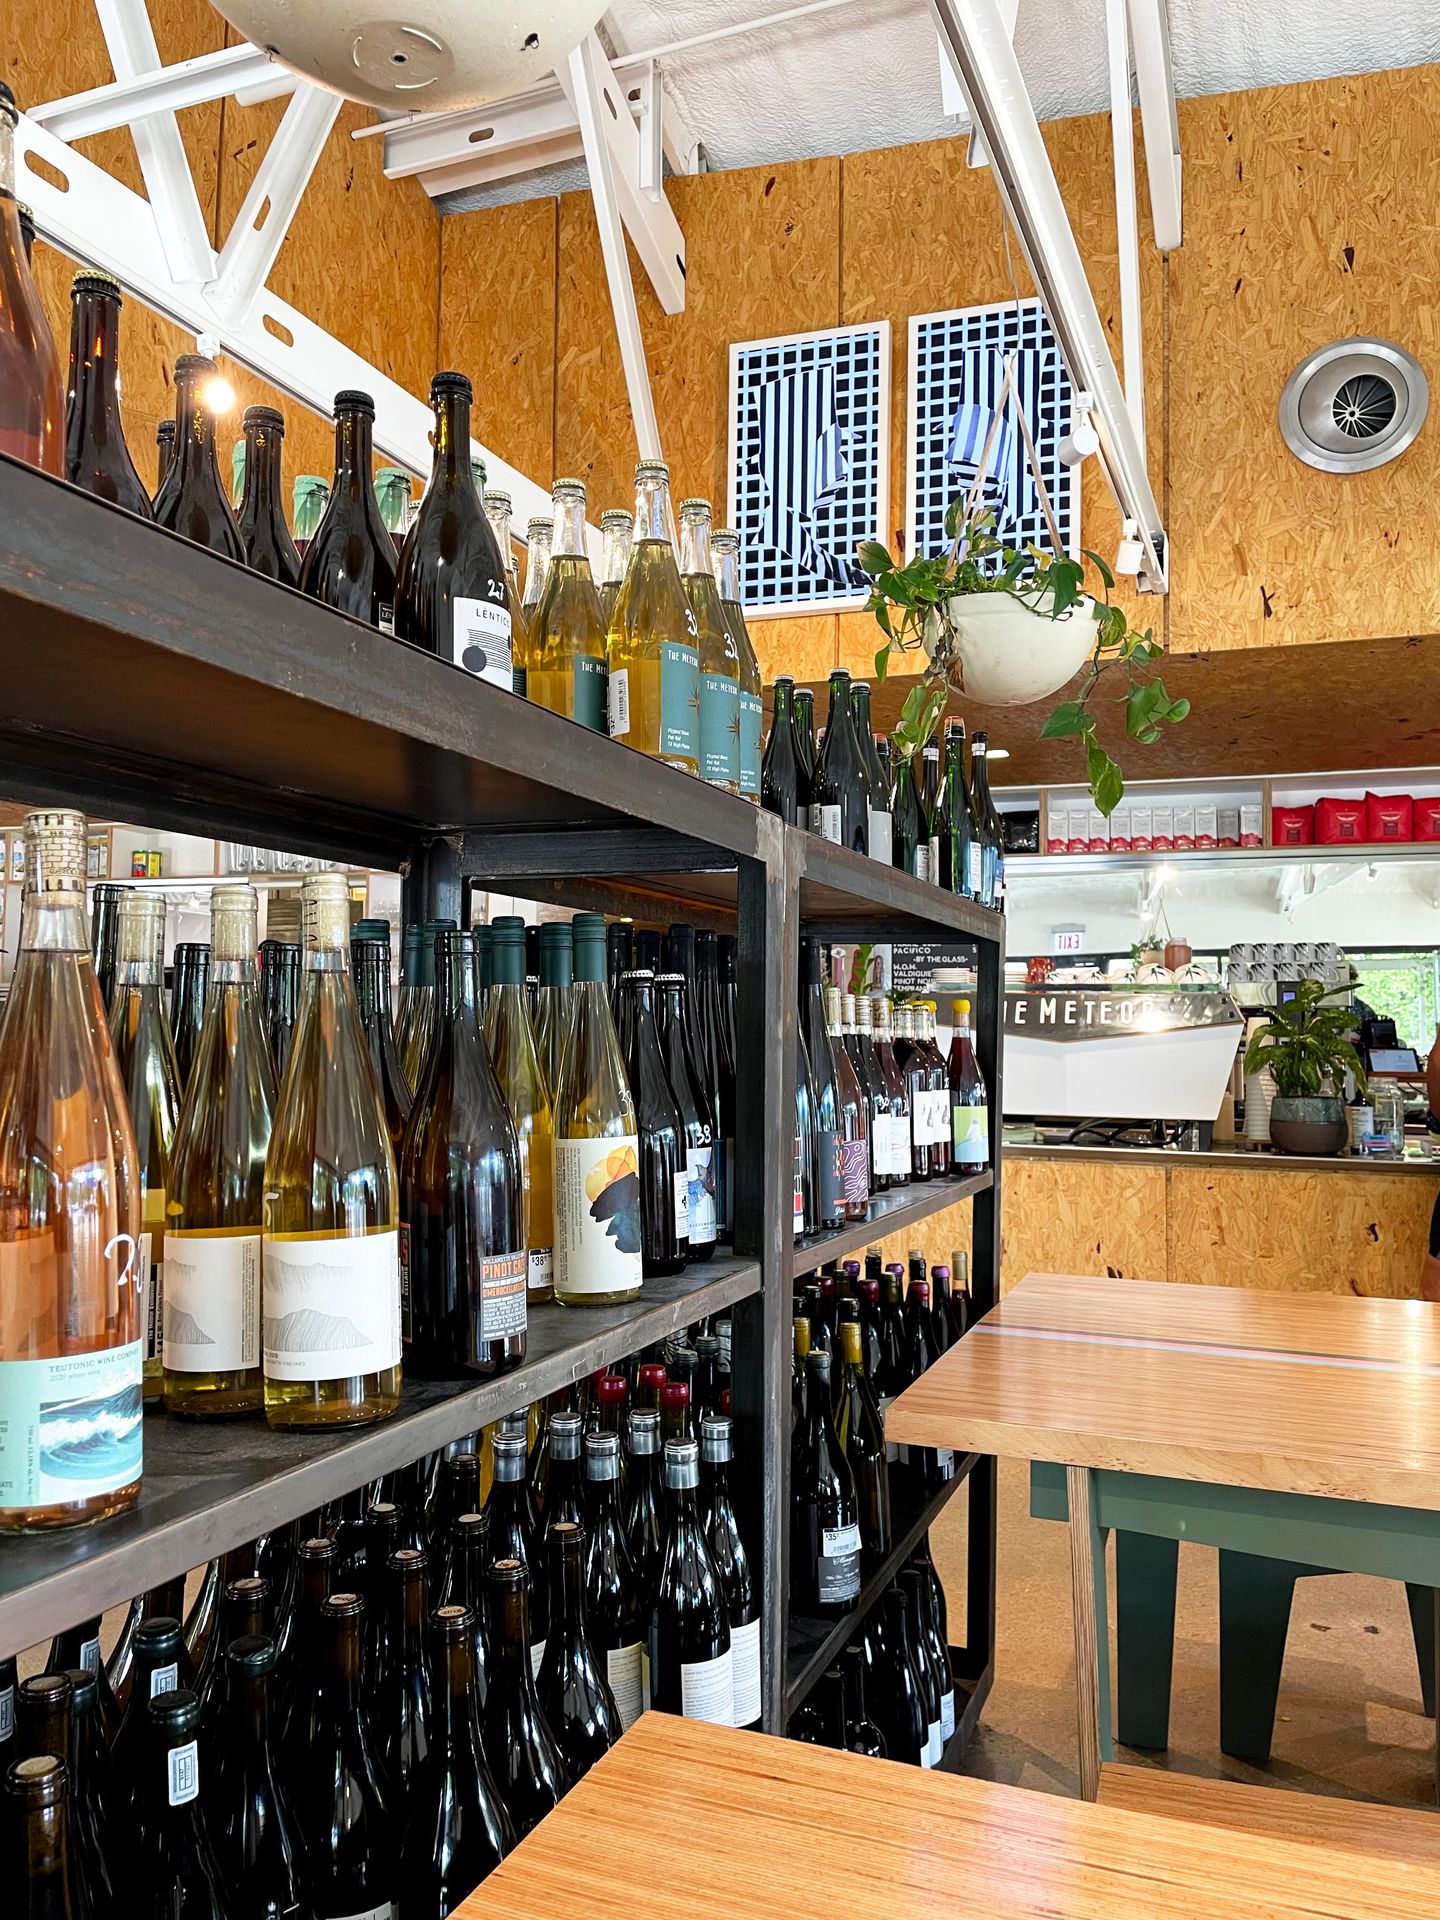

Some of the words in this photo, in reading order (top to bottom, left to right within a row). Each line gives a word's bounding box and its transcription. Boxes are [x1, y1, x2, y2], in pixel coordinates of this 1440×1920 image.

[487, 578, 505, 601] 27
[596, 663, 607, 675] MET
[893, 946, 931, 954] PACIFICO
[696, 1123, 712, 1145] 38
[482, 1261, 513, 1280] PINOT
[49, 1360, 95, 1373] TEUTONIC
[96, 1355, 116, 1365] WINE
[116, 1347, 139, 1361] COMPAN
